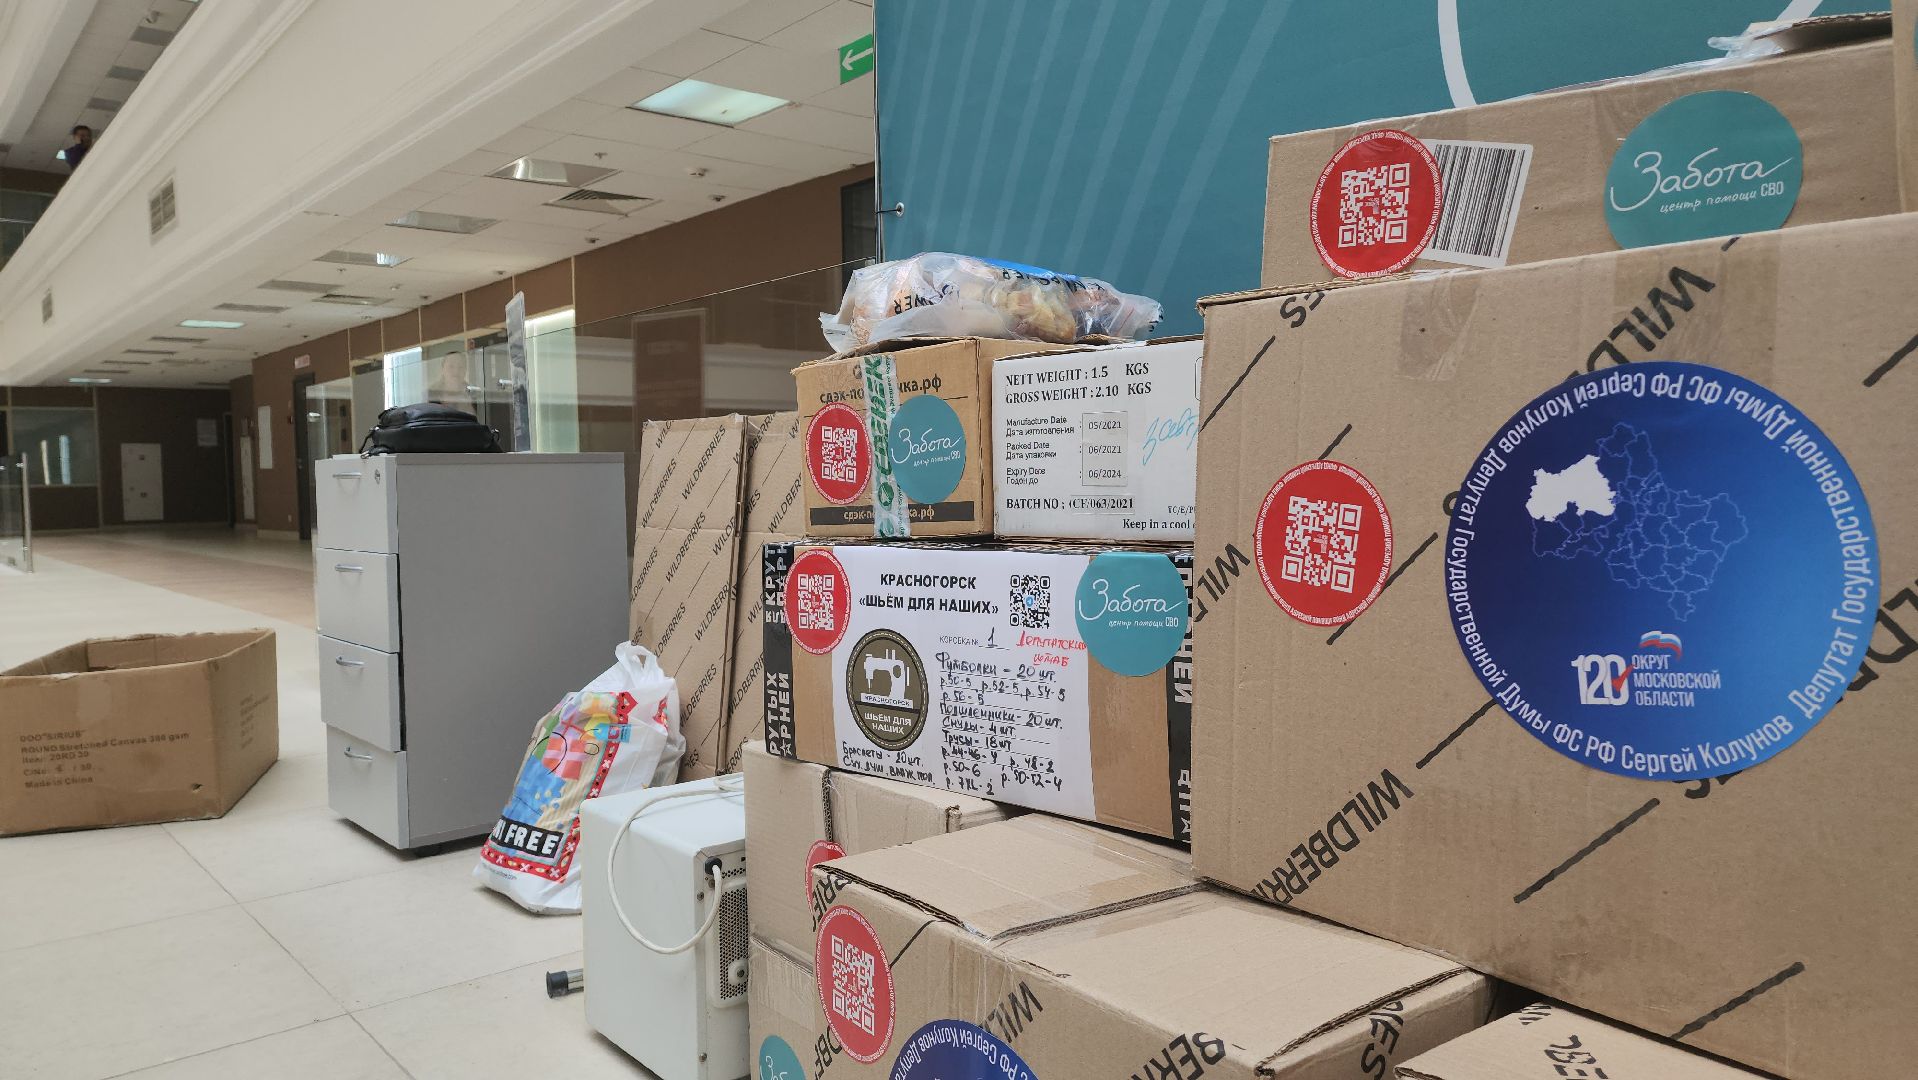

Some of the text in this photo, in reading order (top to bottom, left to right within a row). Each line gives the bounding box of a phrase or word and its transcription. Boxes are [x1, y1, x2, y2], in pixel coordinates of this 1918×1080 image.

[1610, 147, 1794, 212] Забота
[1760, 181, 1785, 197] СВО
[1036, 368, 1082, 384] WEIGHT
[1091, 366, 1109, 379] 1.5
[1125, 362, 1150, 377] KGS
[1650, 372, 1685, 400] РФ
[1005, 381, 1152, 404] GROSS WEIGHT 2.10 KGS
[1574, 371, 1646, 412] Сергей
[1685, 375, 1723, 406] ФС
[1051, 415, 1067, 425] Date
[1088, 420, 1122, 431] 05/2021
[1498, 391, 1574, 454] Колунов
[1725, 386, 1798, 441] Думы
[890, 428, 962, 464] Забота
[1006, 441, 1050, 451] Packed Date
[1088, 445, 1122, 456] 06/2021
[681, 424, 727, 500] WILDBERRIES
[1088, 469, 1122, 480] 06/2024
[1460, 447, 1508, 528] Депутат
[1006, 498, 1059, 510] BATCH NO
[1122, 518, 1191, 531] Keep in a cool
[1780, 427, 1876, 625] Государственной
[665, 511, 707, 584] WILDBERRIES
[880, 573, 977, 590] КРАСНОГОРСК
[859, 594, 999, 615] «ШЬЁМ ДЛЯ НАШИХ»
[1078, 578, 1184, 621] Забота
[1447, 527, 1507, 689] Государственной
[1164, 616, 1179, 628] СВО
[1632, 653, 1671, 670] ОКРУГ
[1787, 626, 1859, 720] Депутат
[1570, 653, 1630, 706] 120
[1633, 669, 1722, 690] МОСКОВСКОЙ
[1496, 682, 1551, 735] Думы
[1635, 690, 1696, 707] ОБЛАСТИ
[872, 722, 905, 735] НАШИХ
[892, 716, 912, 727] ДЛЯ
[1552, 722, 1584, 753] ФС
[1585, 735, 1616, 765] РФ
[1697, 713, 1795, 770] Колунов
[1621, 742, 1698, 777] Сергей
[504, 823, 560, 855] FREE
